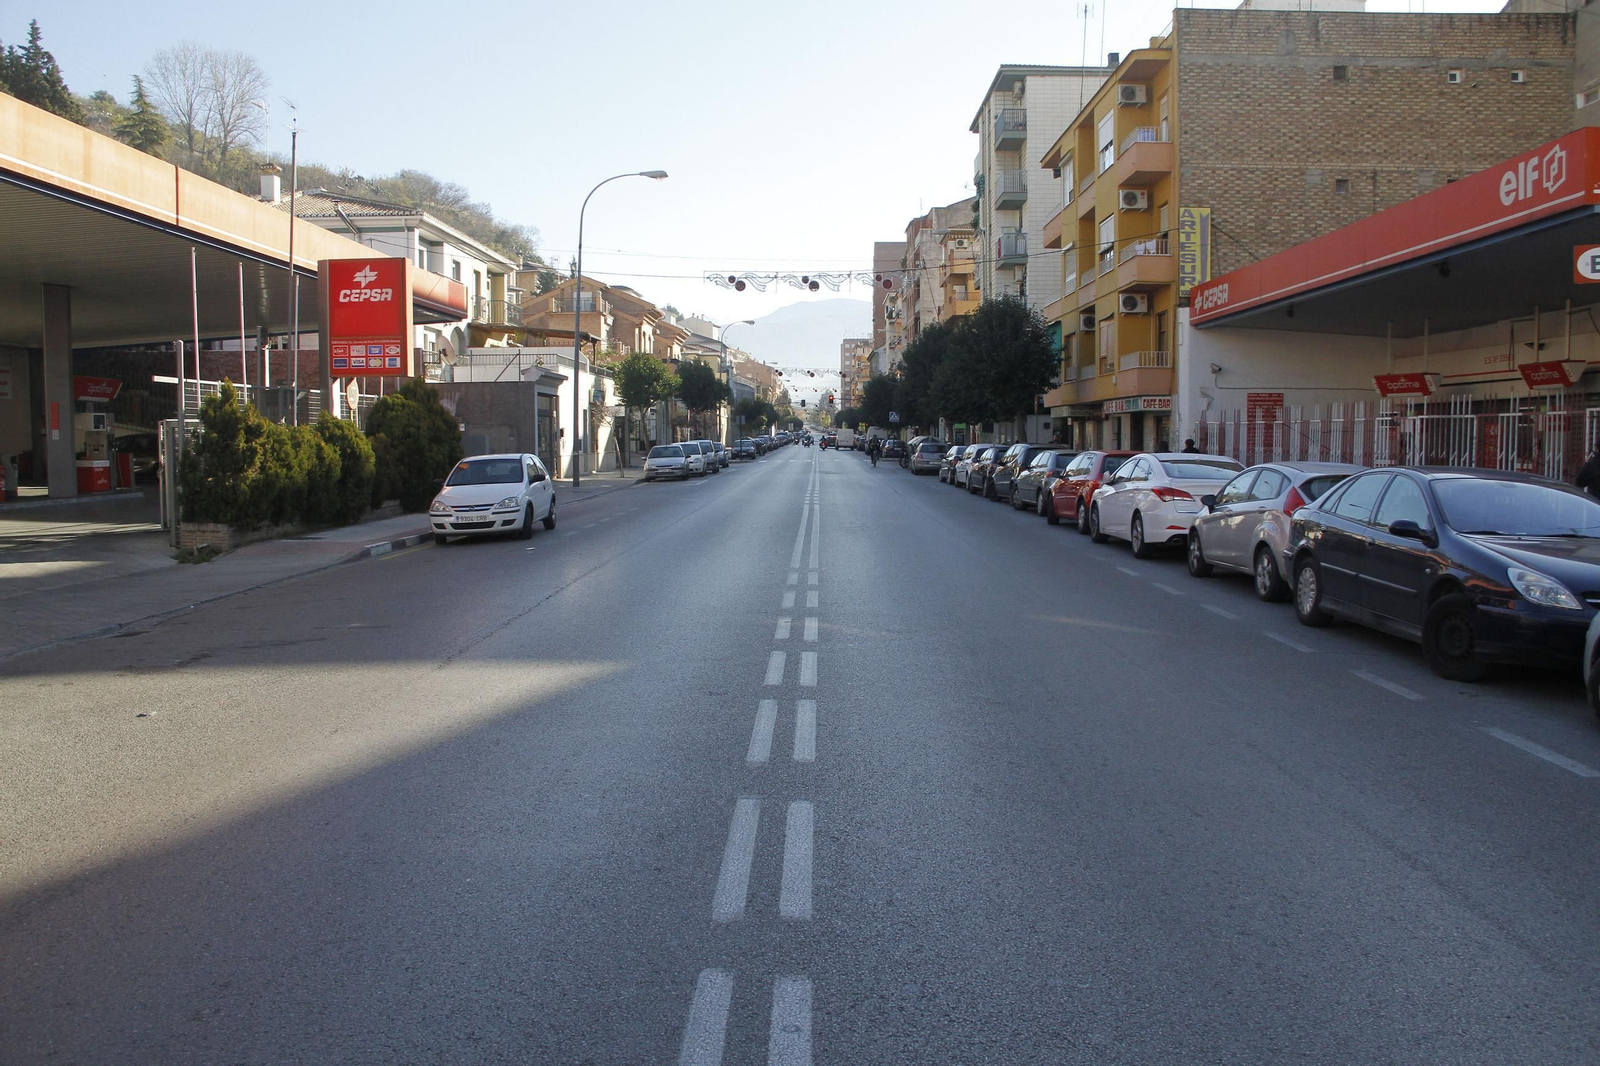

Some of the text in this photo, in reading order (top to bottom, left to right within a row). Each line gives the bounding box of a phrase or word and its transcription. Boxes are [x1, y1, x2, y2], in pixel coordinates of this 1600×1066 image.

[1499, 156, 1539, 206] elf
[1180, 208, 1197, 287] ARTESUR
[339, 288, 393, 303] CEPSA
[1202, 283, 1229, 310] CEPSA
[1531, 369, 1560, 382] optima
[88, 384, 113, 394] optima
[1387, 381, 1419, 391] optima
